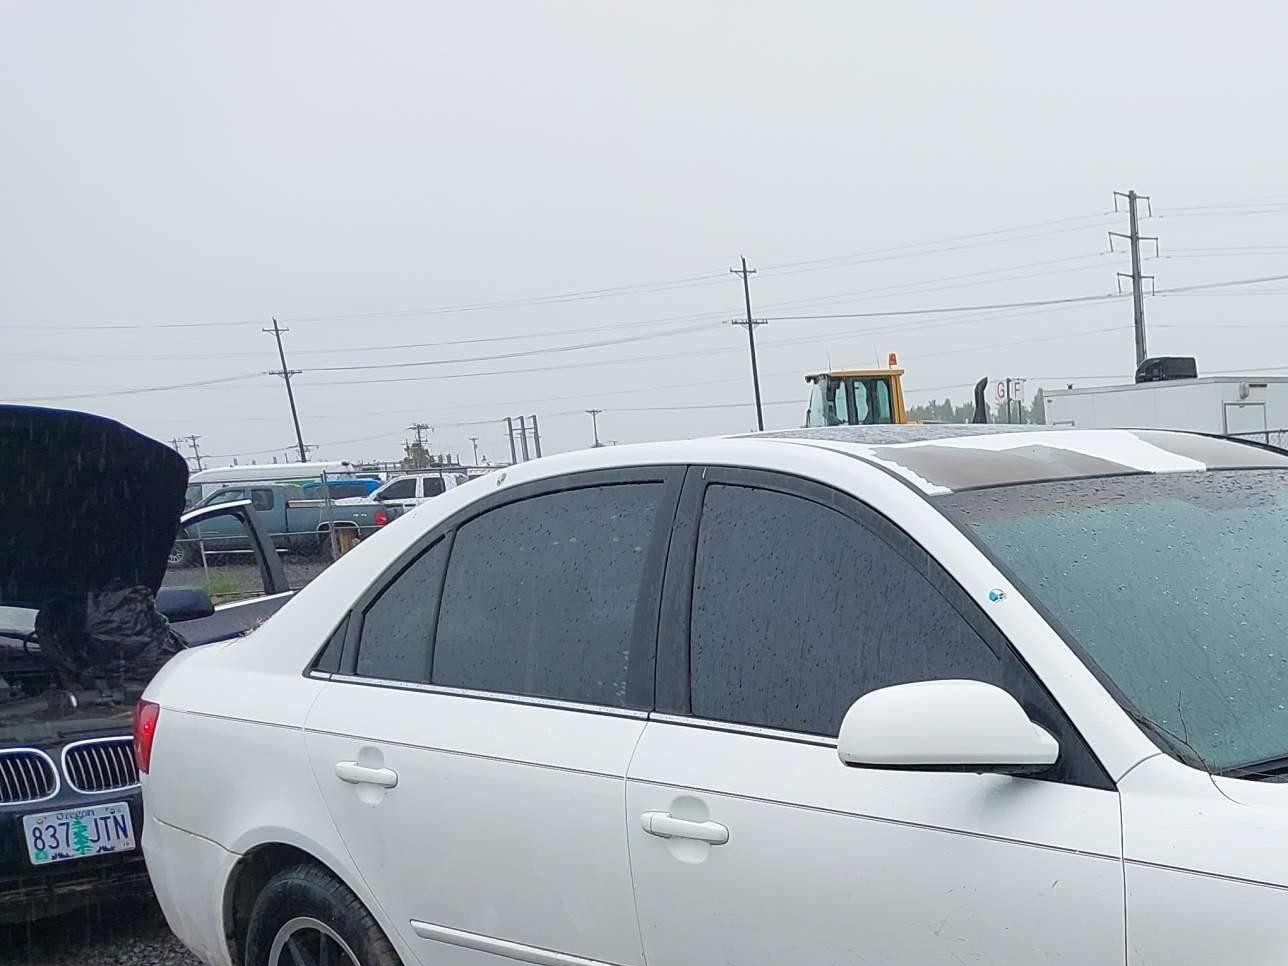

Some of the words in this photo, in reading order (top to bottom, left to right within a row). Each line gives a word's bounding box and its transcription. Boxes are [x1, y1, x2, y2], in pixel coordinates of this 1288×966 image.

[997, 381, 1005, 398] G
[1014, 382, 1021, 398] F
[56, 808, 95, 820] Oregon
[32, 821, 71, 851] 837
[90, 814, 129, 844] JTN
